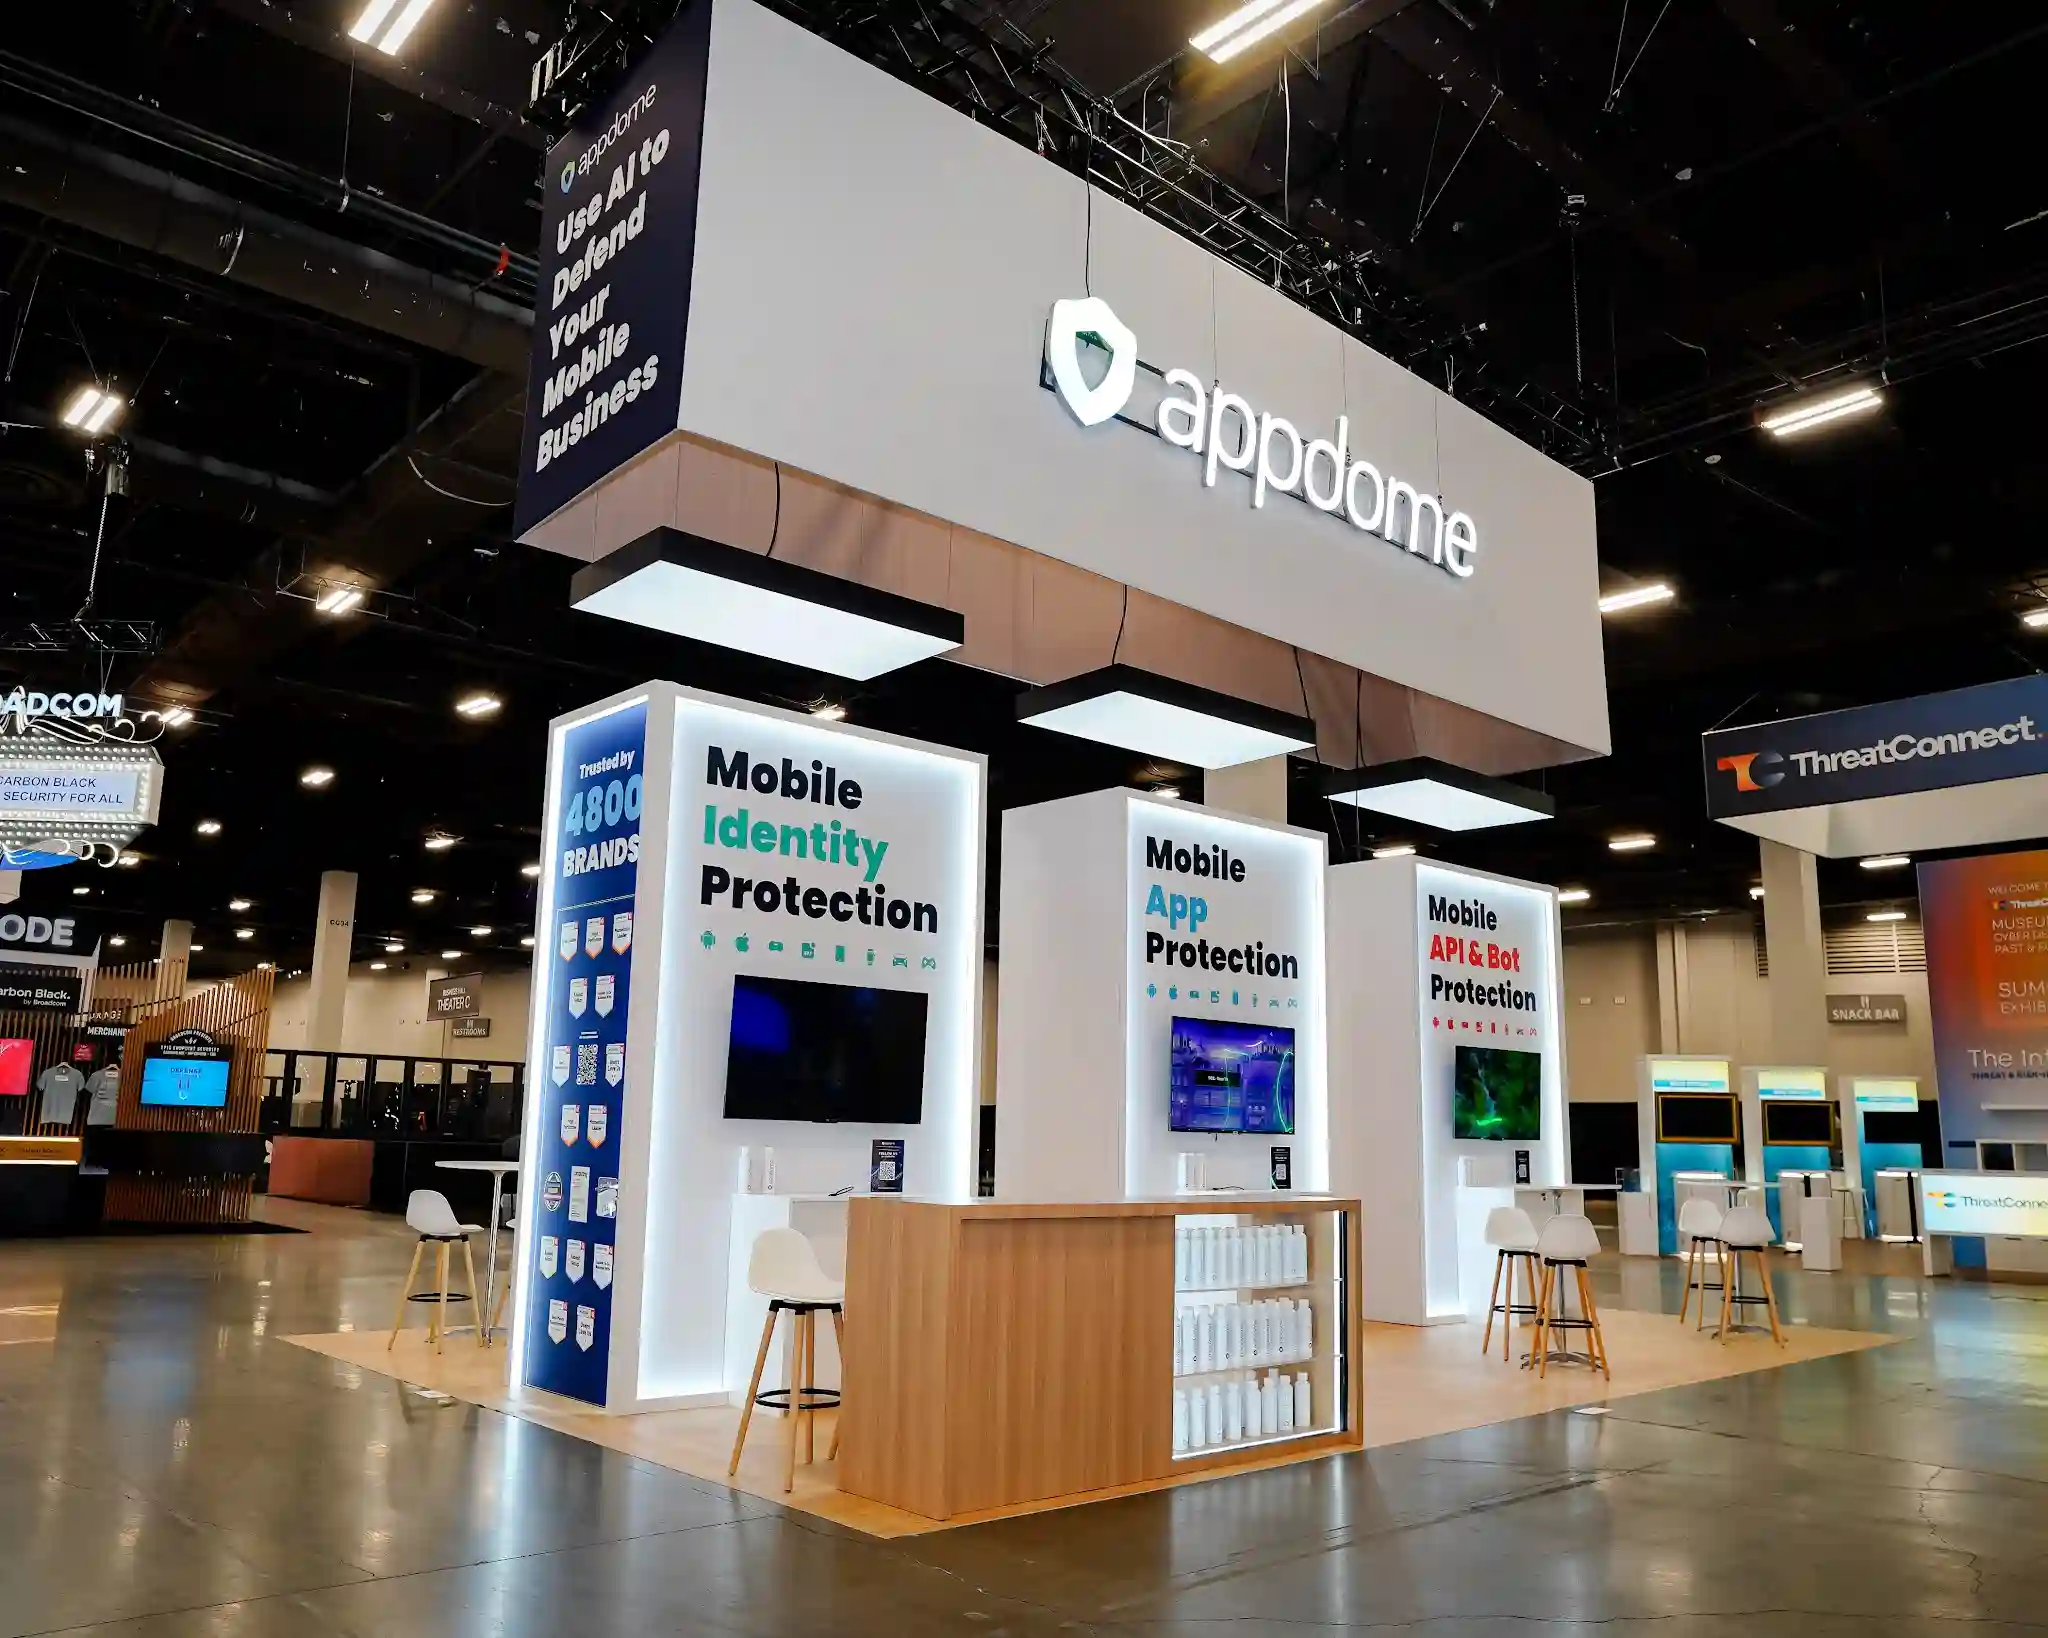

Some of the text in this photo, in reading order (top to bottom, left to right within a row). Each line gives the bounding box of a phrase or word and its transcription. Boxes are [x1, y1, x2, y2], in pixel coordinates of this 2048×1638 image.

[577, 84, 658, 176] appdome
[557, 127, 670, 255] Use AI to
[551, 190, 648, 311] Defend
[549, 283, 611, 361] Your
[541, 321, 630, 418] Mobile
[536, 354, 659, 473] Business
[1155, 367, 1478, 578] appdome
[0, 691, 124, 717] ADCOM
[53, 777, 97, 788] BLACK
[580, 750, 636, 780] Trusted by
[706, 745, 863, 810] Mobile
[3, 791, 123, 804] SECURITY FOR ALL
[565, 774, 644, 837] 4800
[563, 833, 641, 878] BRANDS
[704, 804, 889, 883] Identity
[1146, 836, 1246, 882] Mobile
[700, 864, 938, 934] Protection
[1145, 884, 1208, 933] App
[1428, 894, 1497, 931] Mobile
[1992, 914, 2048, 931] MUSEU
[1146, 931, 1298, 979] Protection
[1429, 934, 1520, 972] API & Bot
[33, 999, 67, 1007] Broadcom
[437, 997, 465, 1011] THEATER
[1430, 973, 1537, 1012] Protection
[1998, 980, 2048, 999] SUM
[453, 1028, 486, 1036] RESTROOMS
[1832, 1008, 1900, 1020] SNACK BAR
[1967, 1049, 2013, 1068] The
